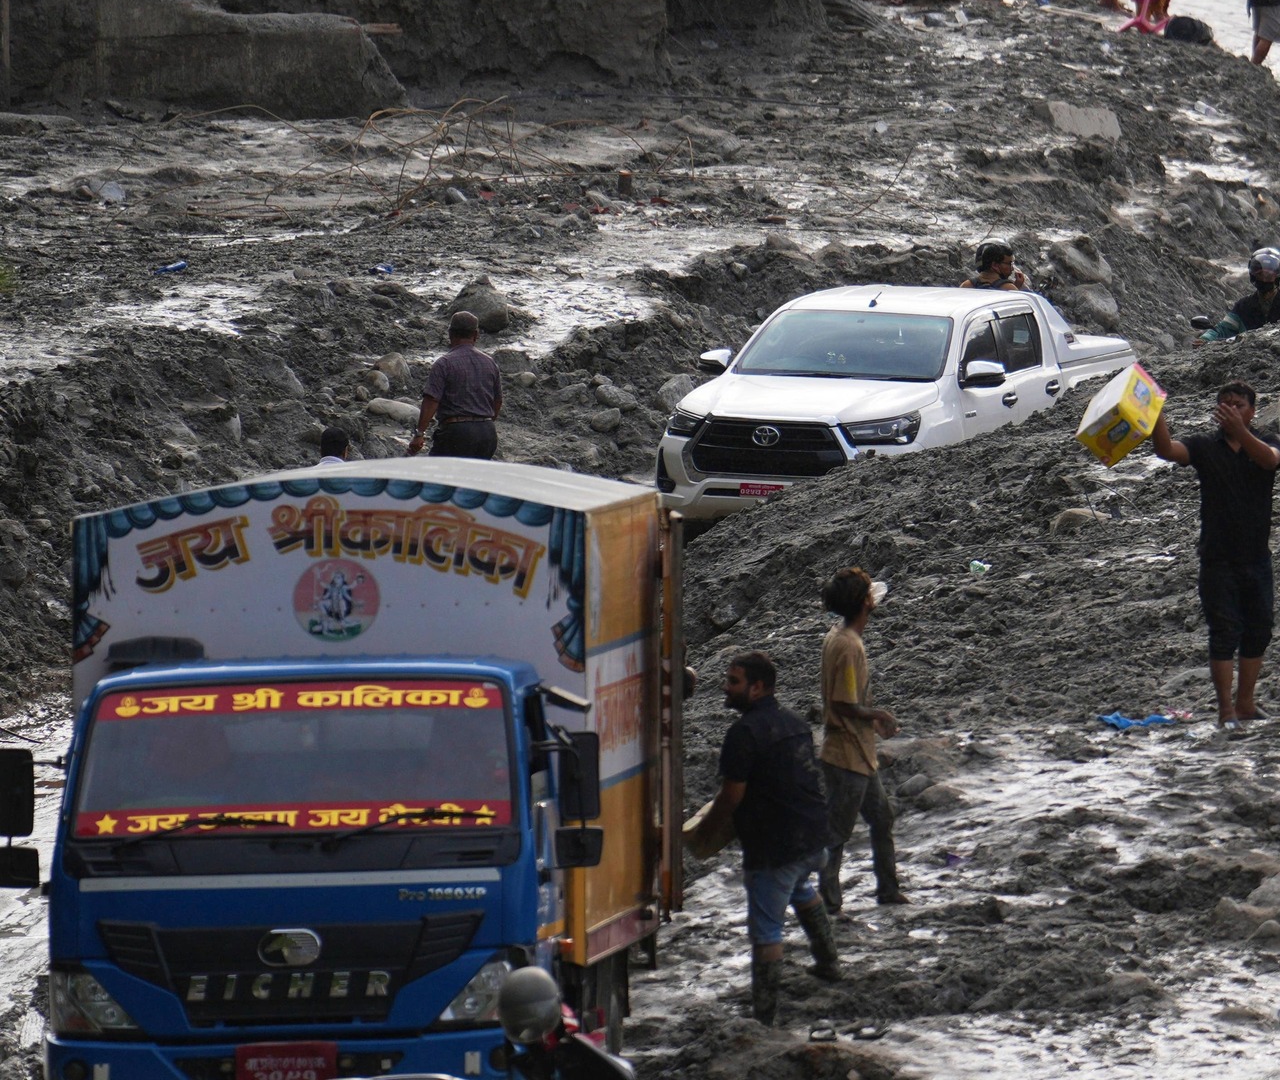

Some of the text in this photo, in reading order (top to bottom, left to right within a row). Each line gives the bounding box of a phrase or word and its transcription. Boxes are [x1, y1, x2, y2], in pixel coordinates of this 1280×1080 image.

[135, 514, 251, 595] जय
[142, 685, 463, 713] जय श्री कालिका
[308, 808, 371, 827] जय
[186, 969, 391, 1001] EICHER
